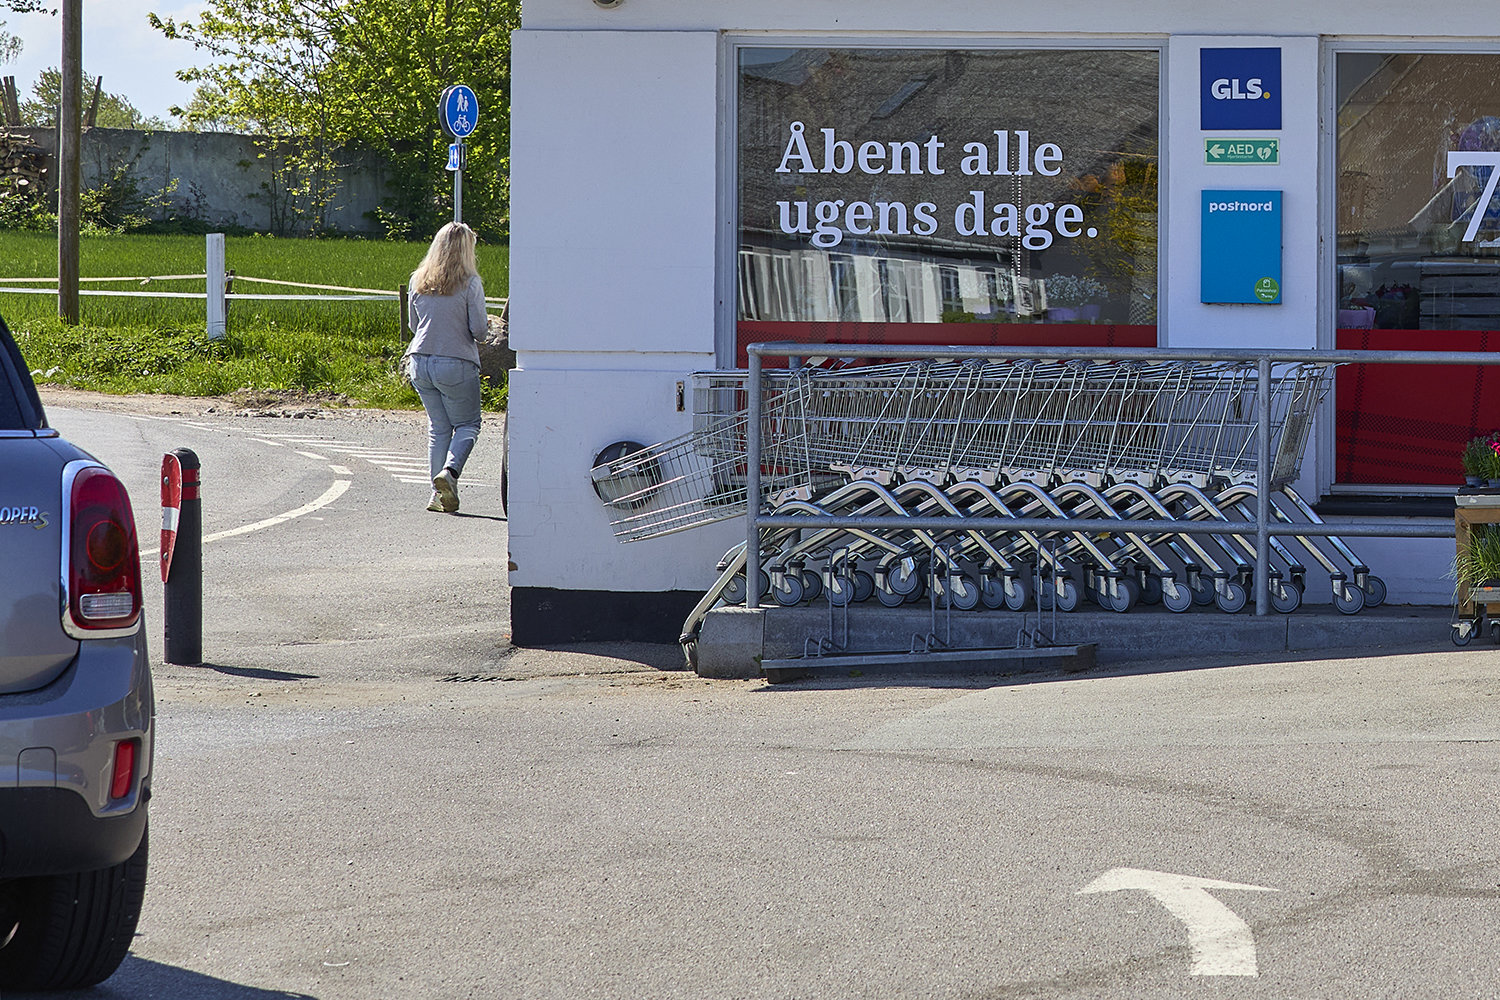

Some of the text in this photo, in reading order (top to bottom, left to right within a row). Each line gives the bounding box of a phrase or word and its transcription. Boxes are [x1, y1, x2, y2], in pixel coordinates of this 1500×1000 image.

[775, 121, 1064, 176] Åbent alle
[1227, 144, 1254, 155] AED
[776, 190, 1099, 250] ugens dage.
[1209, 201, 1273, 213] postnord
